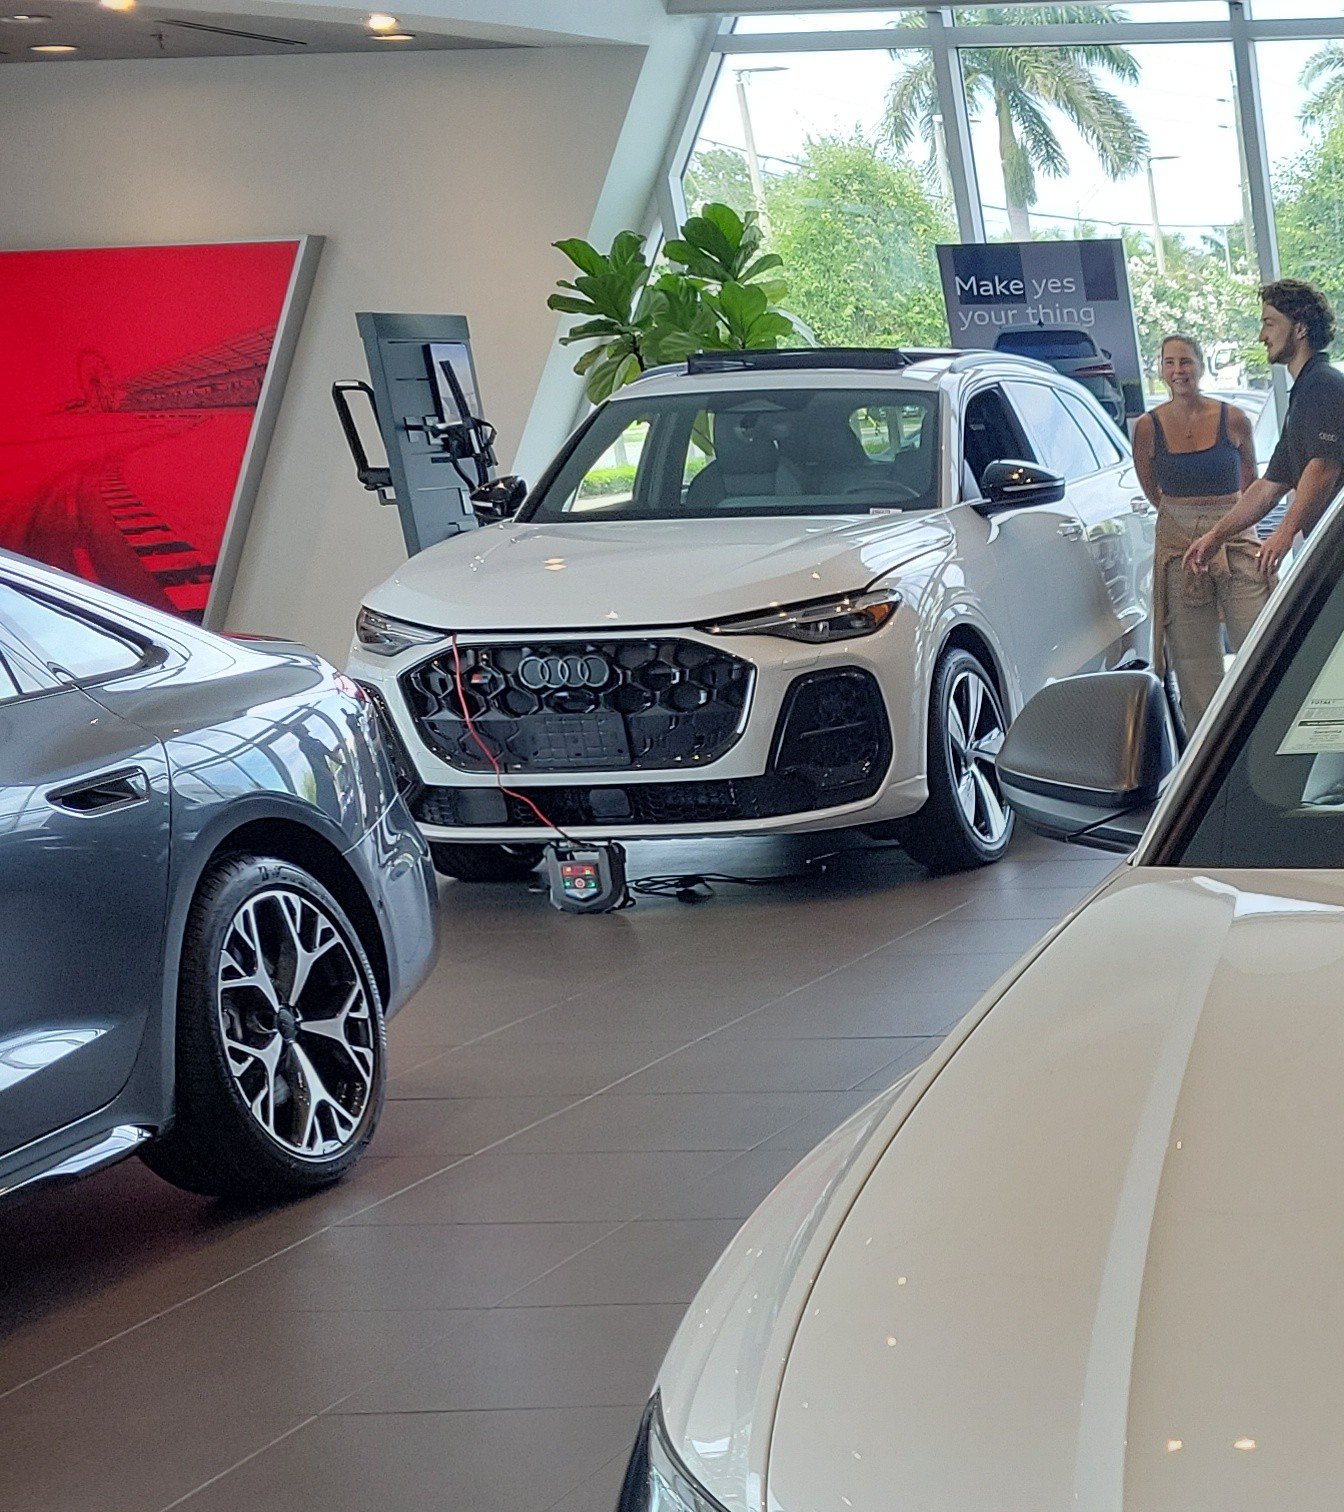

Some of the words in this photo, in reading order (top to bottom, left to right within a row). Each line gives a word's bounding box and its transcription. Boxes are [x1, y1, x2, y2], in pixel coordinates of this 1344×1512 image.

[955, 275, 1024, 297] Make
[1031, 276, 1076, 299] yes
[957, 308, 1018, 331] your
[1026, 303, 1095, 326] thing
